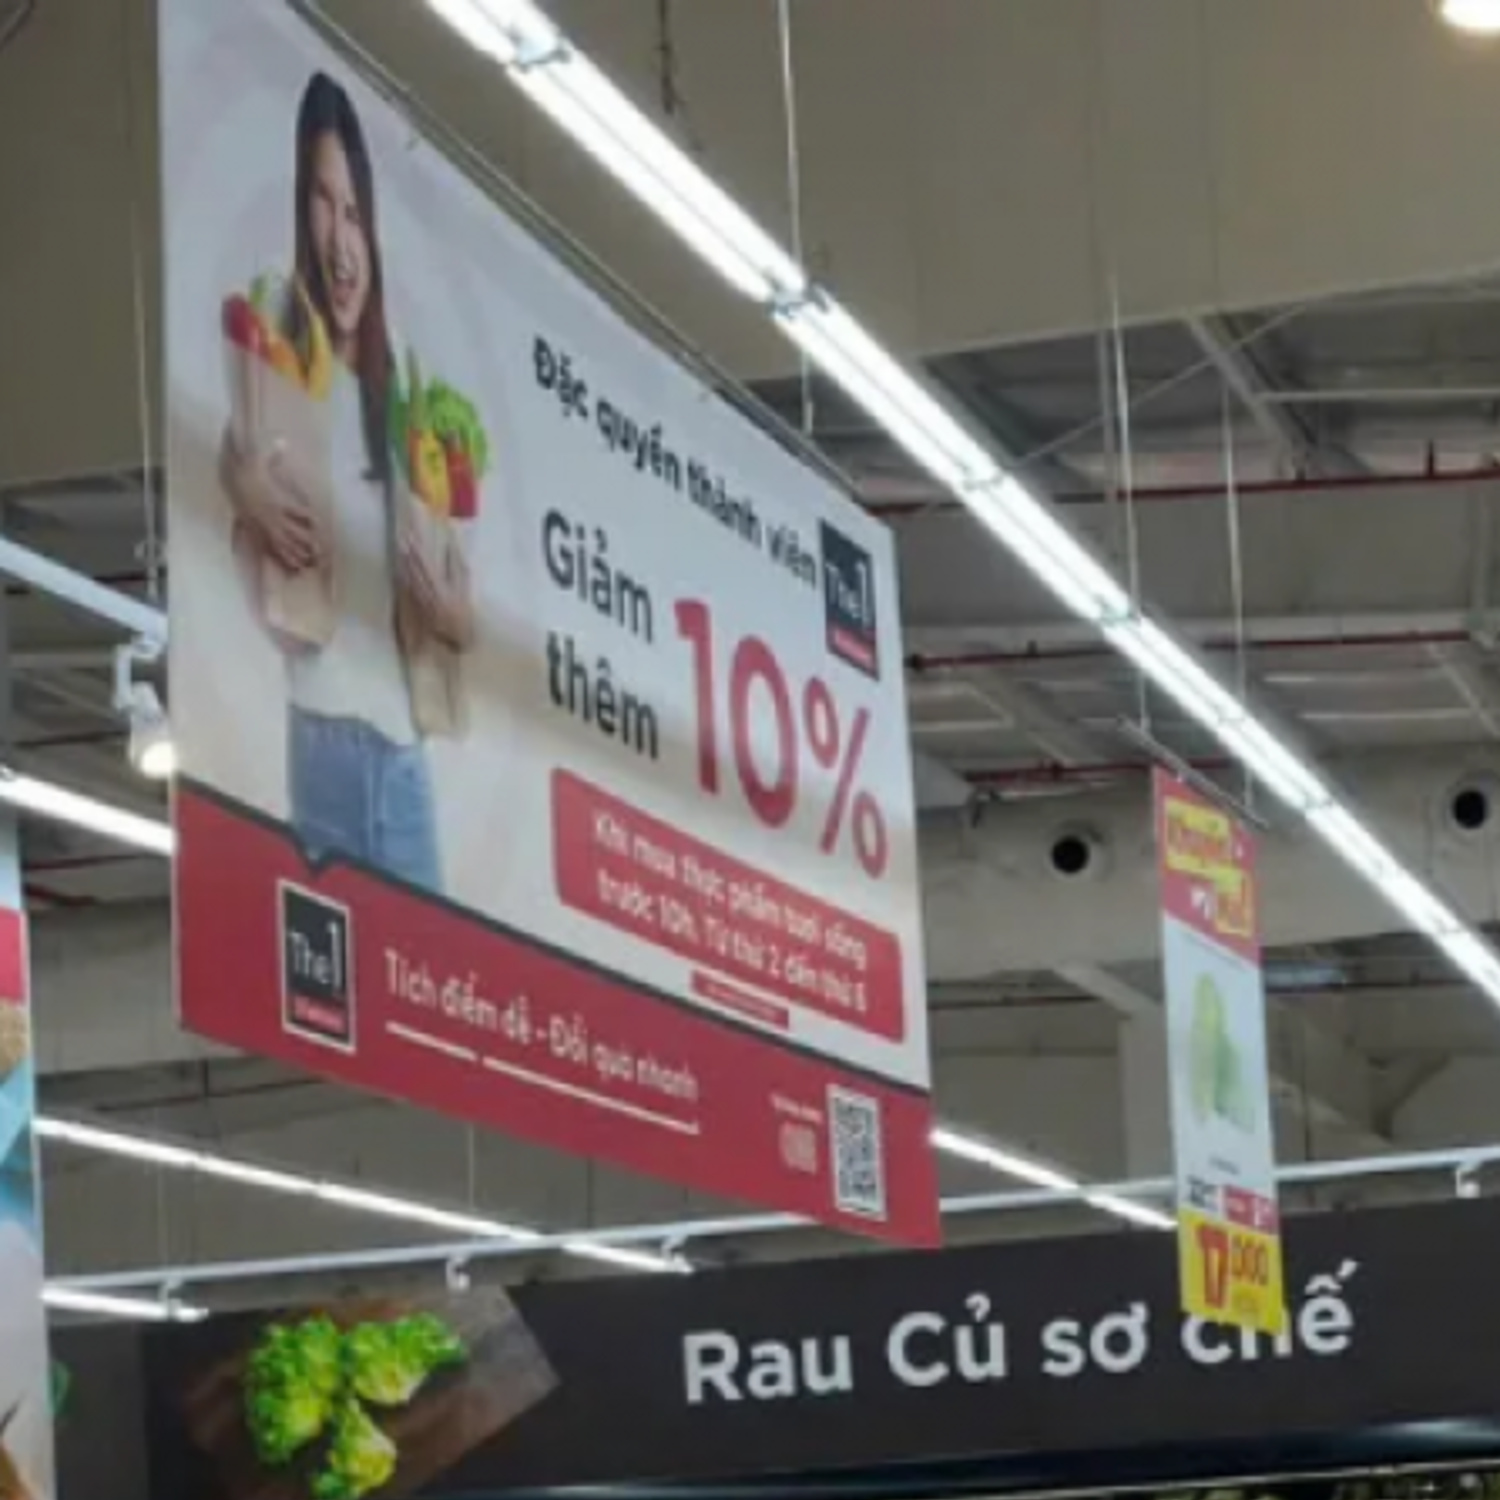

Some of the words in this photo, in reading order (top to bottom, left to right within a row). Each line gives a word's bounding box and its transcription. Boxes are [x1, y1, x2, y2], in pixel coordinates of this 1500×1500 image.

[533, 335, 589, 420] Đặc
[596, 397, 682, 493] quyền
[542, 506, 654, 645] Giảm
[546, 630, 659, 761] thêm
[673, 598, 888, 880] 10%
[383, 945, 437, 1011] Tích
[682, 1328, 854, 1405] Rau
[887, 1293, 1006, 1387] Củ
[1041, 1302, 1151, 1377] sơ
